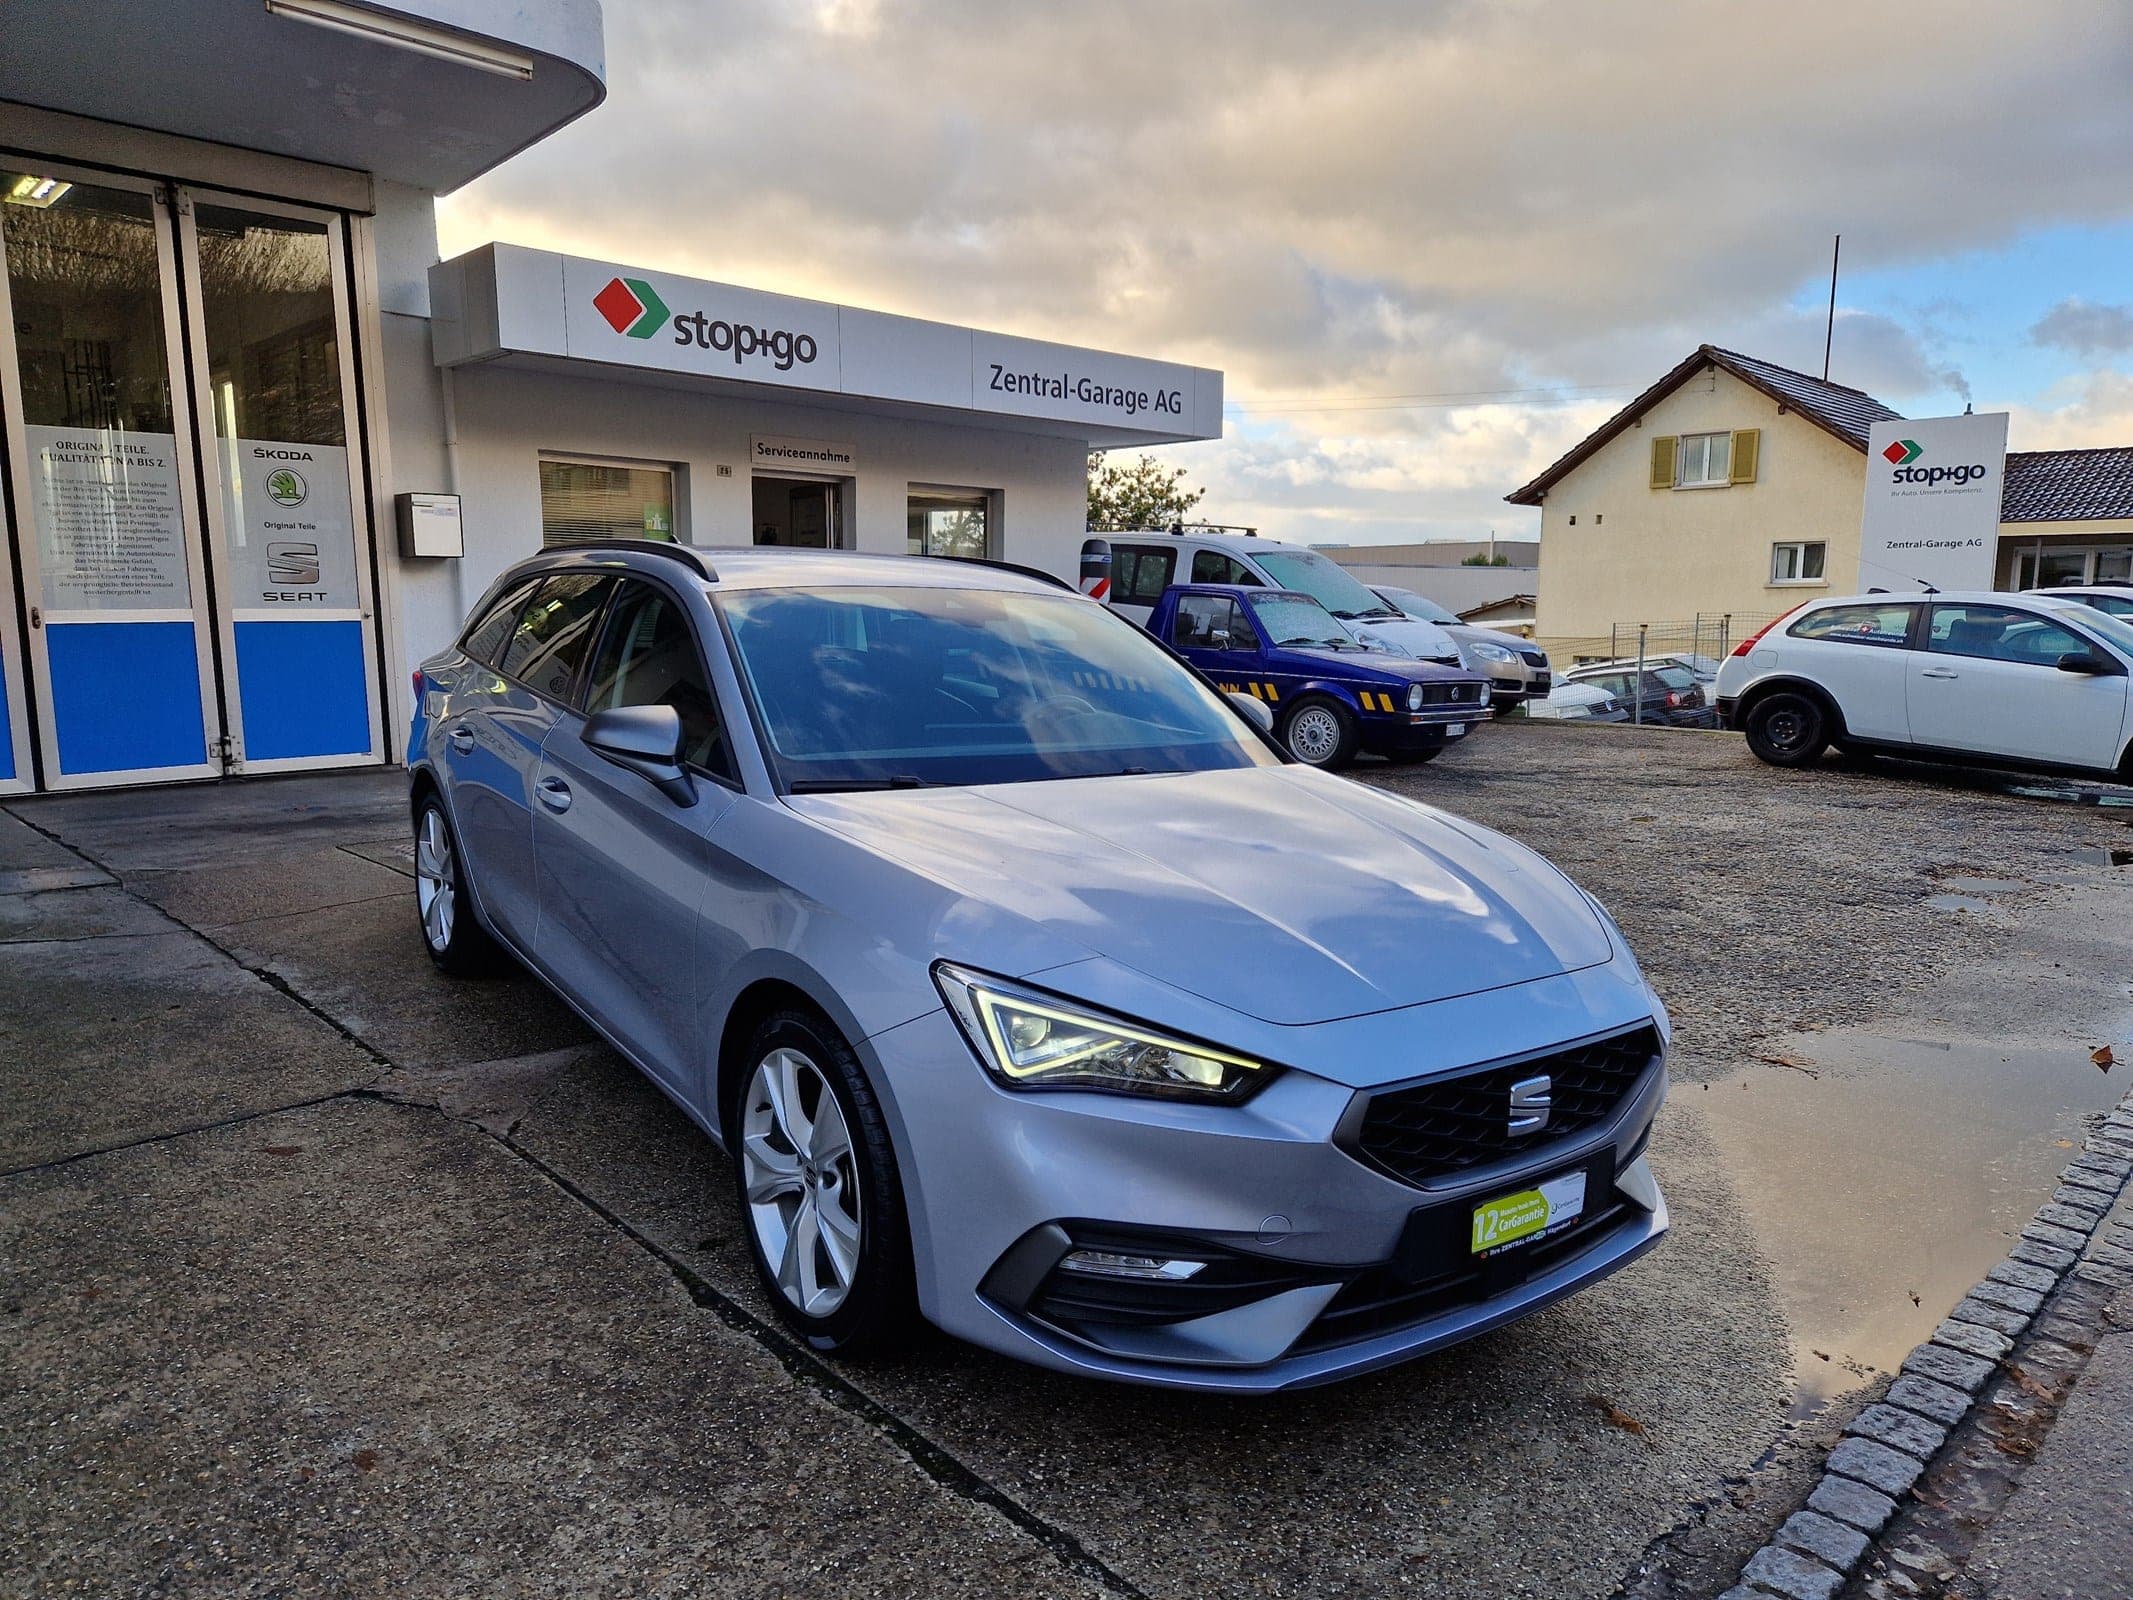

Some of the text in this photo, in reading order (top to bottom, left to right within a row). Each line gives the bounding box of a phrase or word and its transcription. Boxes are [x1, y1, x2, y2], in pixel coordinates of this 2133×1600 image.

[673, 309, 818, 371] stop+go
[989, 363, 1183, 415] Zentral-Garage AG
[56, 441, 149, 455] ORIGINA TEILE.
[253, 446, 314, 462] ŠKODA
[756, 440, 851, 464] Serviceannahme
[126, 458, 135, 466] A
[137, 458, 154, 467] BIS
[157, 459, 166, 468] Z.
[1892, 464, 1986, 487] stop+go
[264, 521, 316, 531] Original Teile
[1886, 538, 1983, 549] Zentral-Garage AG
[262, 591, 328, 602] SEAT
[1475, 1209, 1499, 1244] 12
